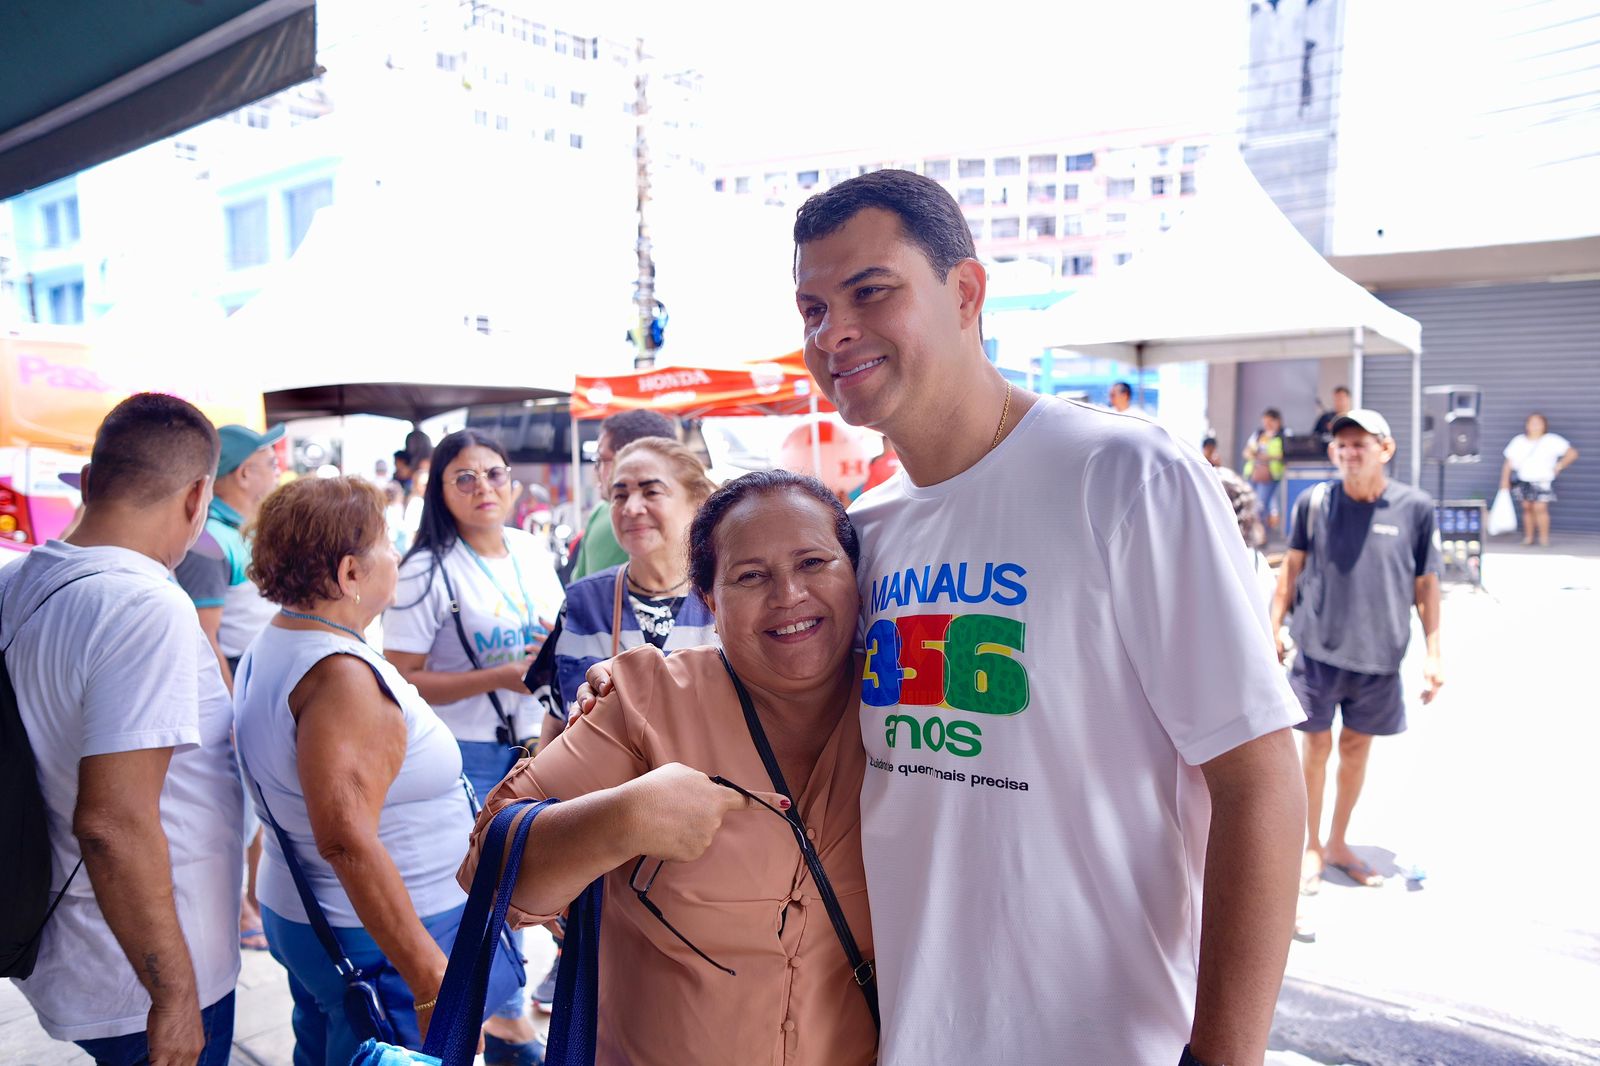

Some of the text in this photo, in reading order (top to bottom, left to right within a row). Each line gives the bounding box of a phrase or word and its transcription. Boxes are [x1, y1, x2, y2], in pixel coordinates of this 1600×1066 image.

[638, 370, 711, 392] HONDA
[871, 562, 1027, 614] MANAUS
[861, 613, 1030, 716] 356
[885, 714, 982, 757] anos
[971, 774, 1029, 791] precisa
